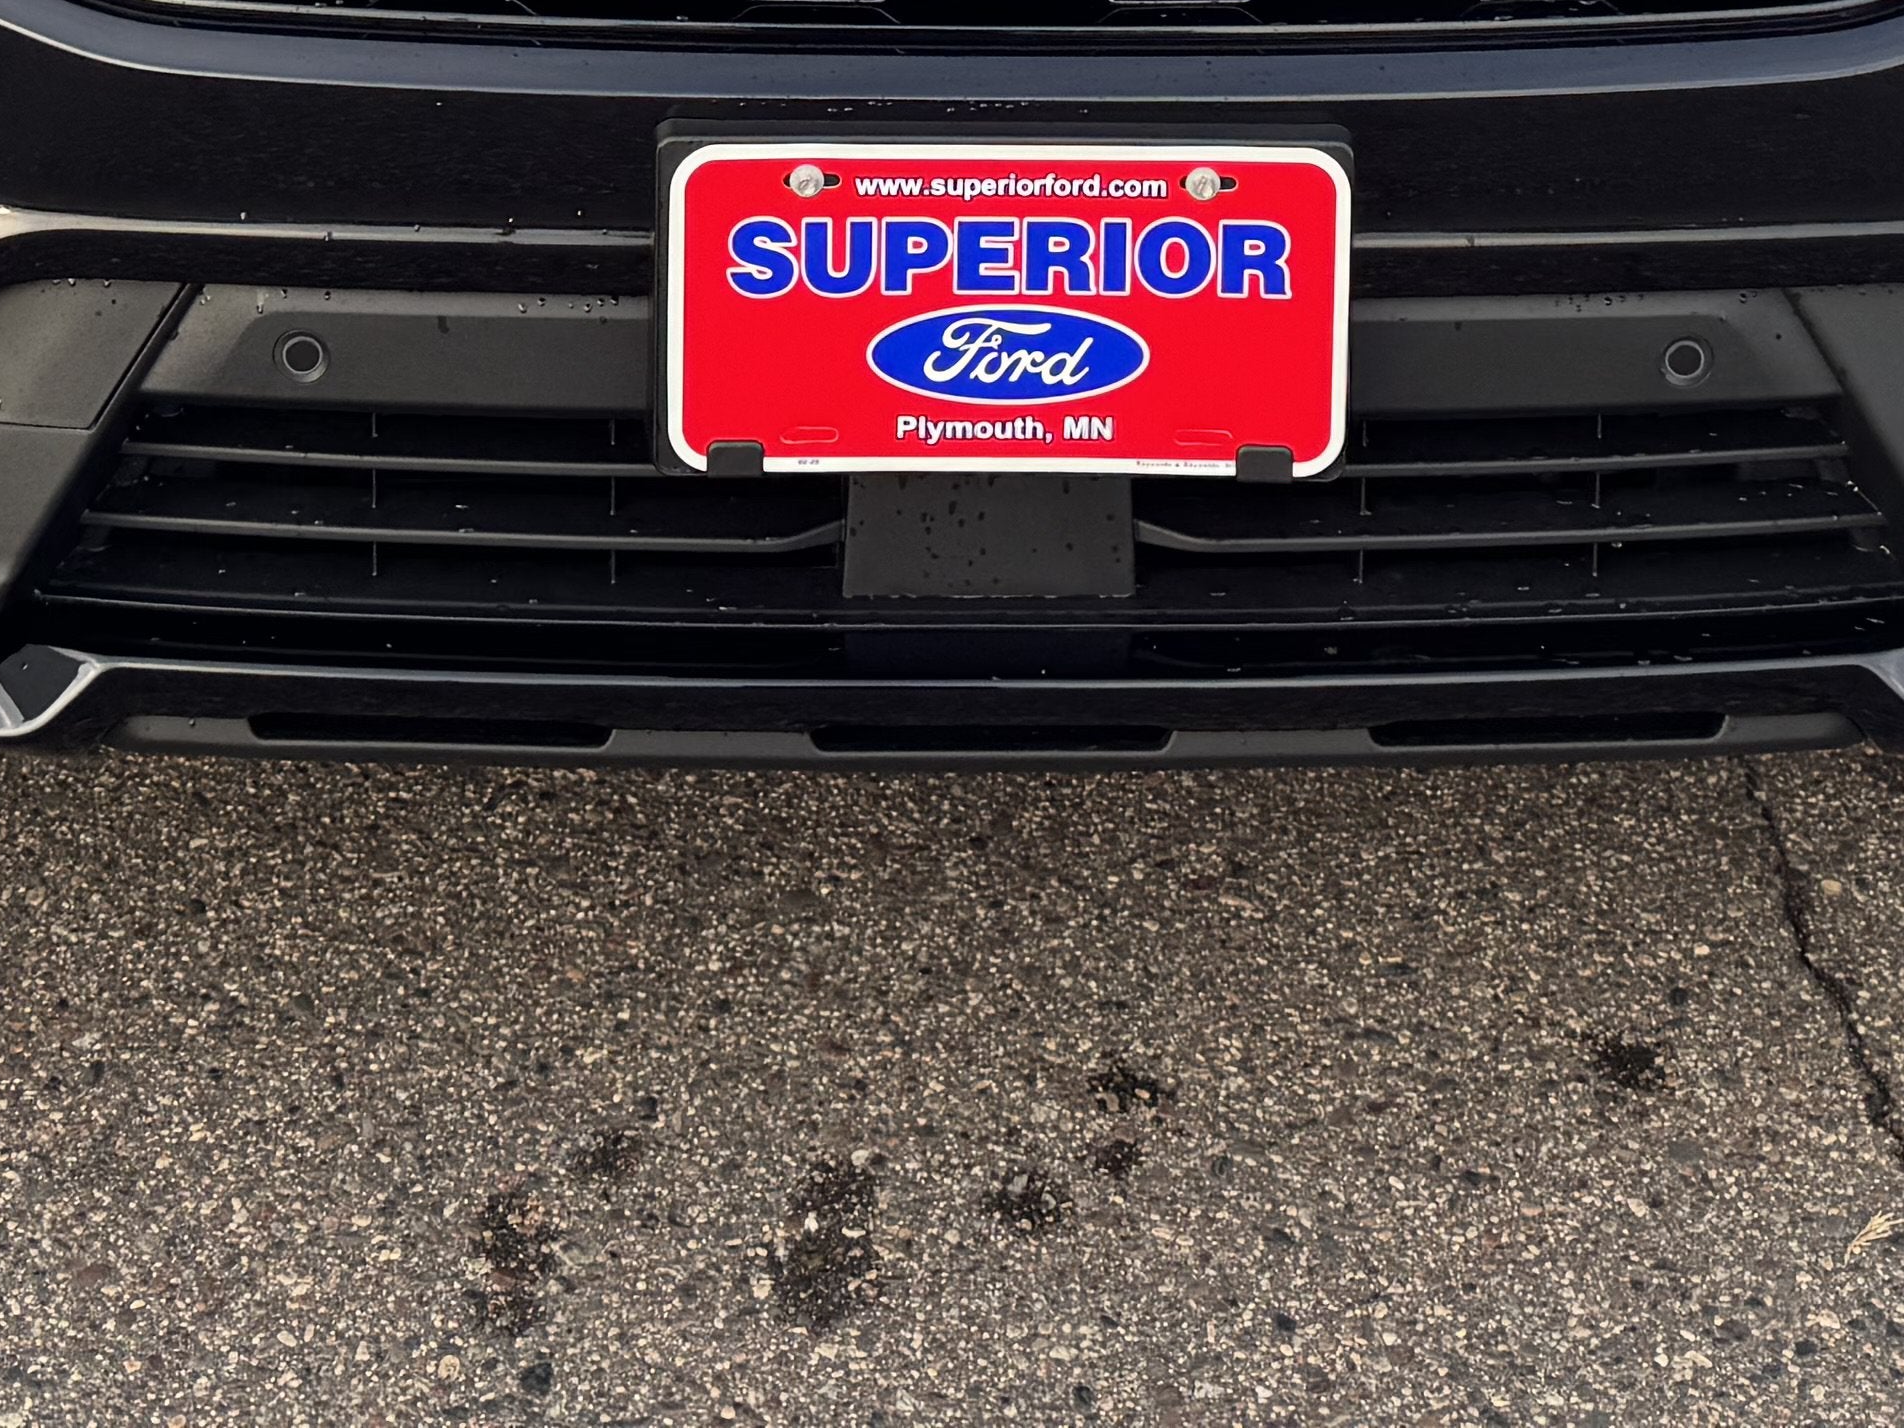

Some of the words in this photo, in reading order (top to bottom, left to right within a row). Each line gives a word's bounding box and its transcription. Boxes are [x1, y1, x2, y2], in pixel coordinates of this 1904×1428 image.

[854, 173, 1167, 200] www.superiorford.com
[726, 216, 1292, 300] SUPERIOR
[923, 317, 1094, 387] Ford
[896, 416, 1052, 443] Plymouth,
[1063, 417, 1114, 441] MN
